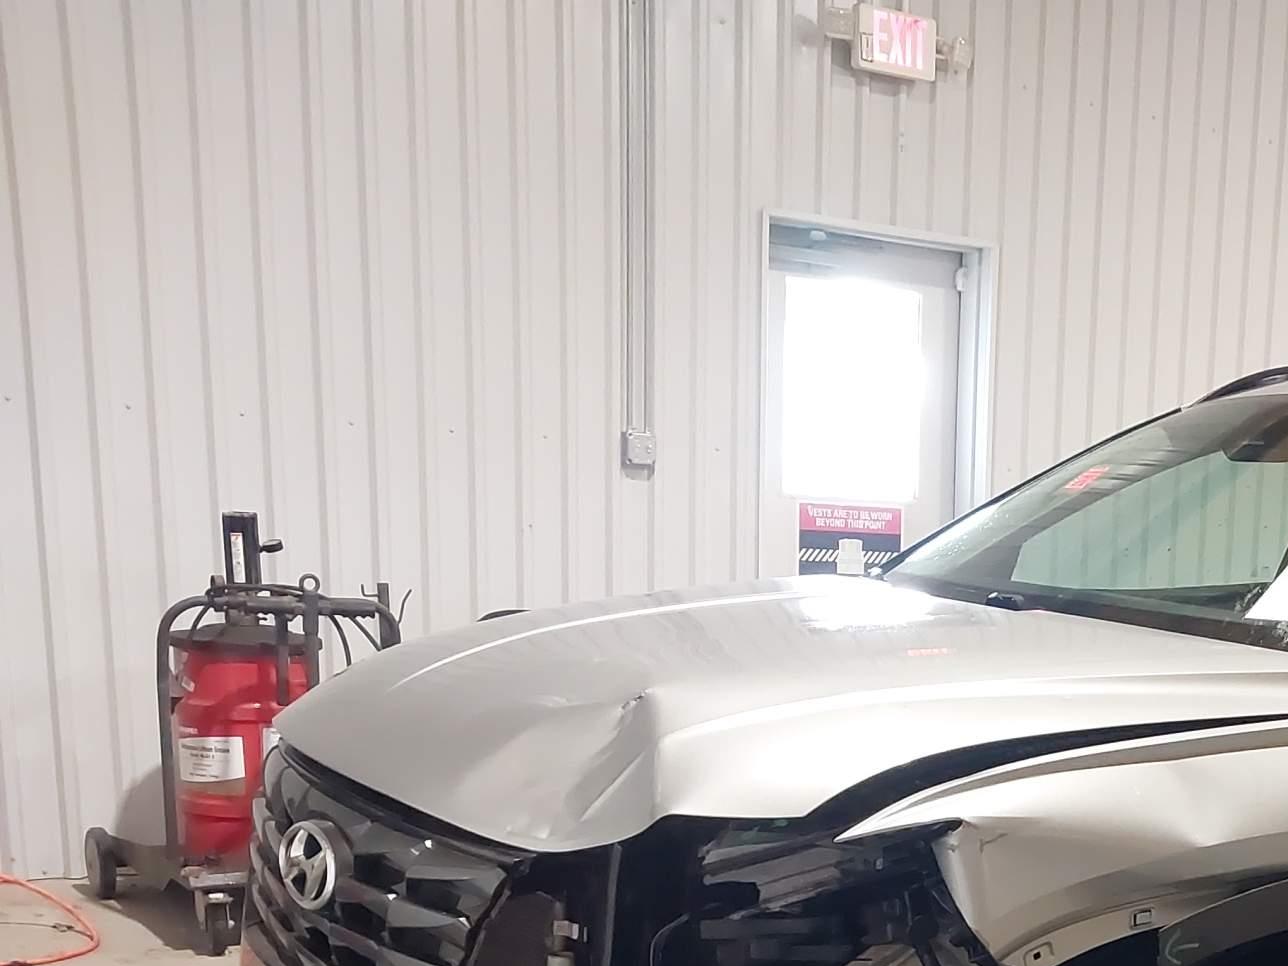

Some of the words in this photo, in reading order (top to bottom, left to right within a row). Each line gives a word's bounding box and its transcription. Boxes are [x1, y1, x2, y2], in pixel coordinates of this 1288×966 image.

[873, 9, 928, 70] EXIT
[807, 505, 832, 517] VESTS
[833, 508, 848, 518] ARE
[850, 510, 858, 519] TO
[816, 518, 845, 528] BEYOND
